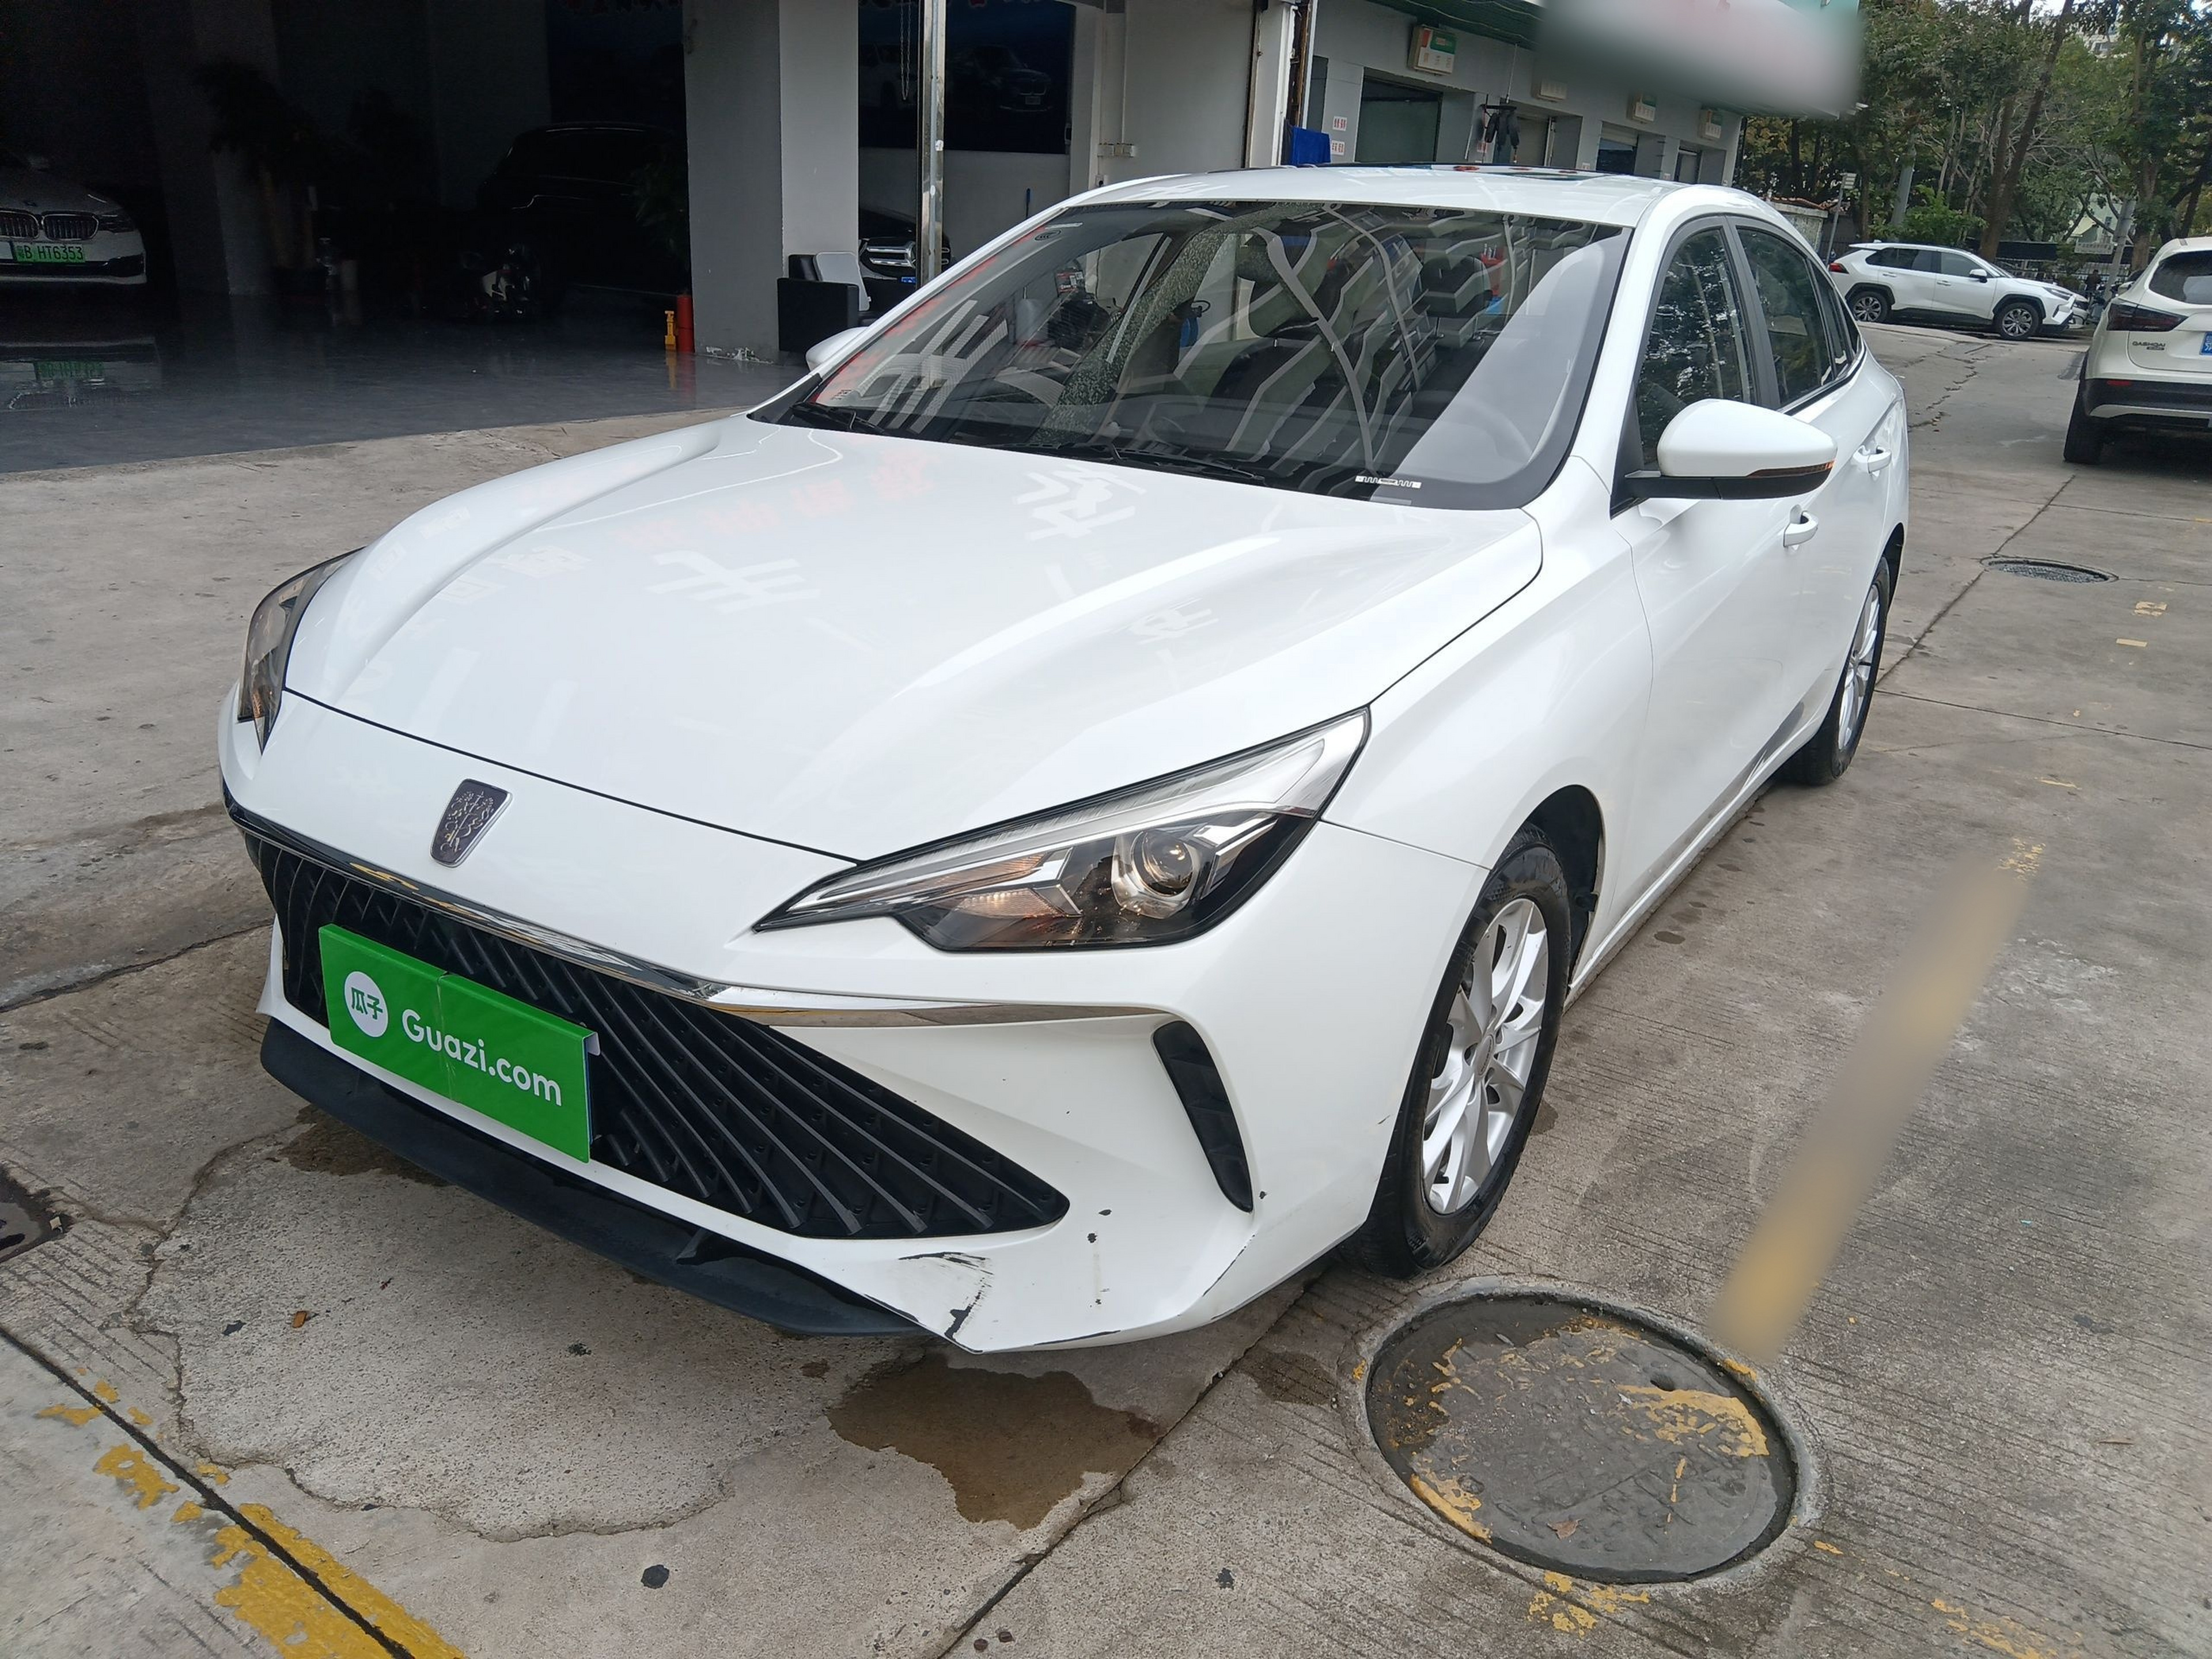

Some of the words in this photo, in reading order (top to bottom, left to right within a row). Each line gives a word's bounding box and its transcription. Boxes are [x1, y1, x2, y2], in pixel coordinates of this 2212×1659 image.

[37, 246, 83, 260] HT6353
[351, 987, 384, 1020] 瓜子
[402, 1009, 562, 1107] Guazi.com
